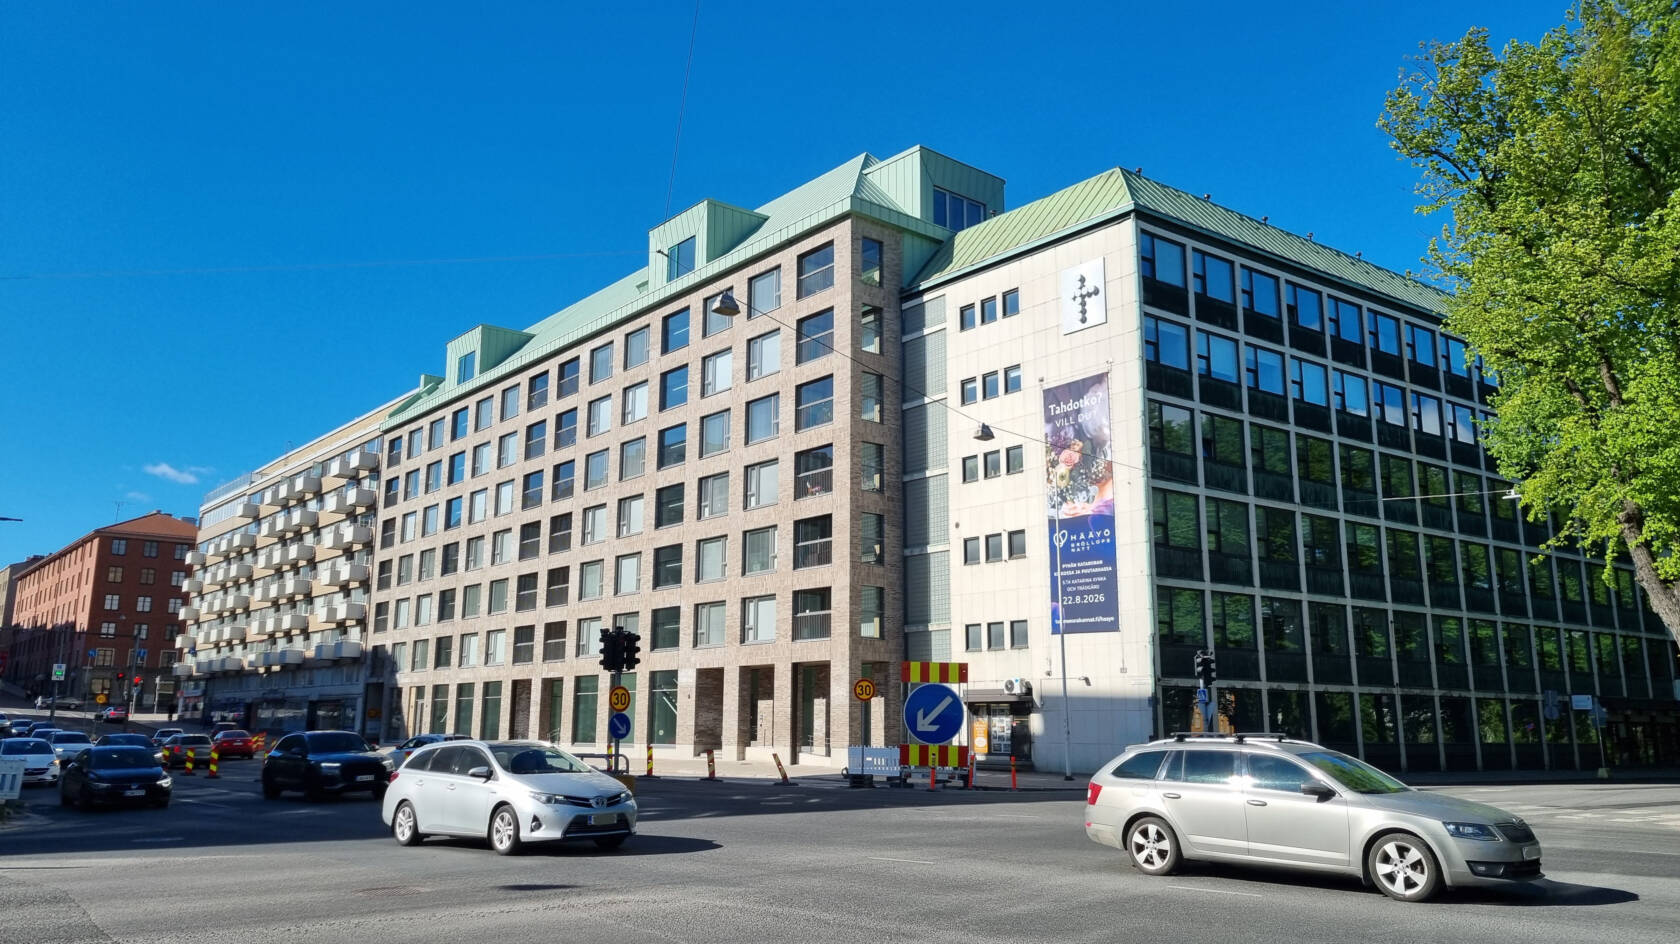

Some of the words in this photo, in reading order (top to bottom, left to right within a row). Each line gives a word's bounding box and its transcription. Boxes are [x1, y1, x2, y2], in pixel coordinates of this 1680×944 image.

[1048, 392, 1103, 415] Tahdotko?
[1055, 416, 1076, 428] VILL
[1063, 594, 1105, 605] 22.8.2026
[857, 684, 871, 696] 30
[613, 692, 627, 706] 30
